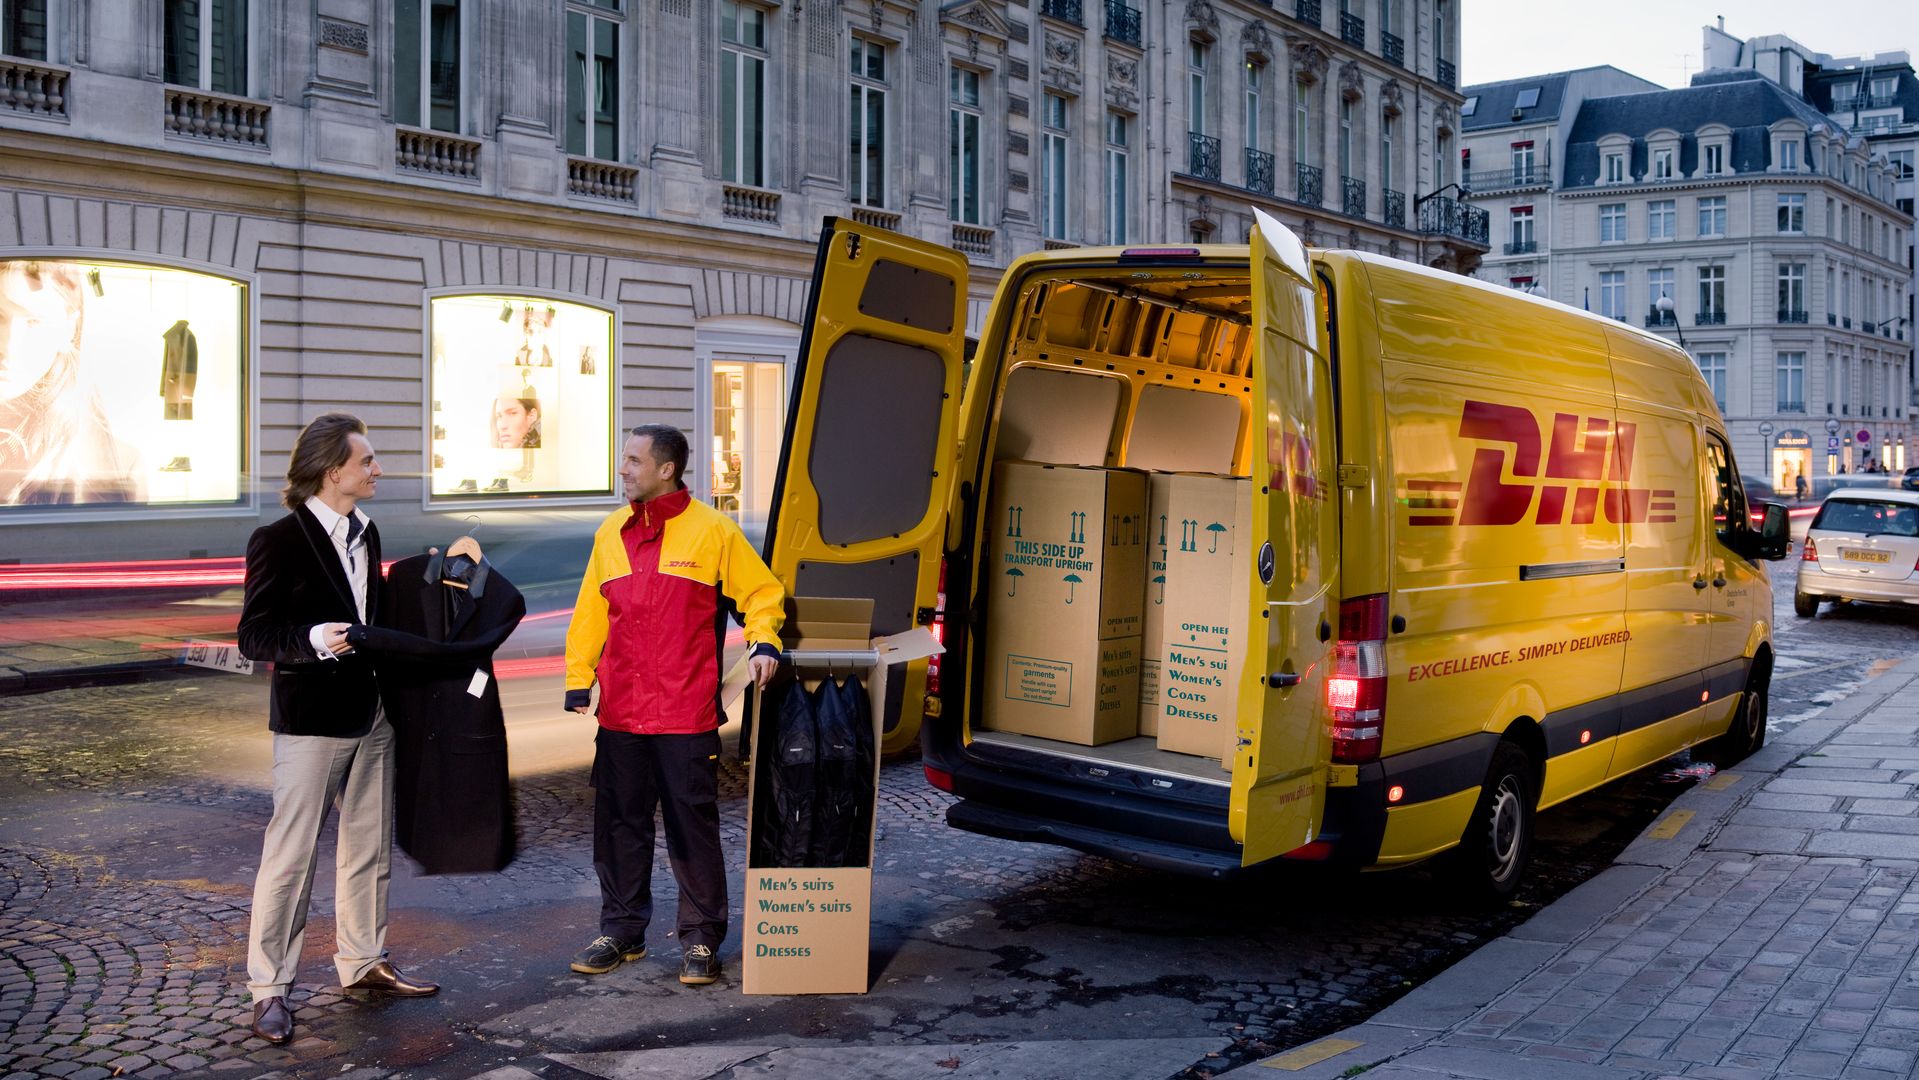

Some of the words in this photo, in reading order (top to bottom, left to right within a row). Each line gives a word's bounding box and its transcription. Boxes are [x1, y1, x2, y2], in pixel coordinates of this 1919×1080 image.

[1459, 399, 1651, 527] DHL
[1015, 541, 1039, 555] THIS
[1042, 543, 1066, 558] SIDE
[1069, 546, 1084, 559] UP
[669, 560, 697, 568] DHL
[1005, 553, 1053, 568] TRANSPORT
[1056, 558, 1093, 571] UPRIGHT
[1107, 617, 1122, 626] OPEN
[1182, 623, 1209, 633] OPEN
[214, 646, 229, 666] YA
[1407, 650, 1513, 682] EXCELLENCE.
[1517, 641, 1567, 662] SIMPLY
[1569, 630, 1633, 652] DELIVERED.
[1024, 669, 1056, 679] garments
[1279, 784, 1316, 805] www.dhl.com
